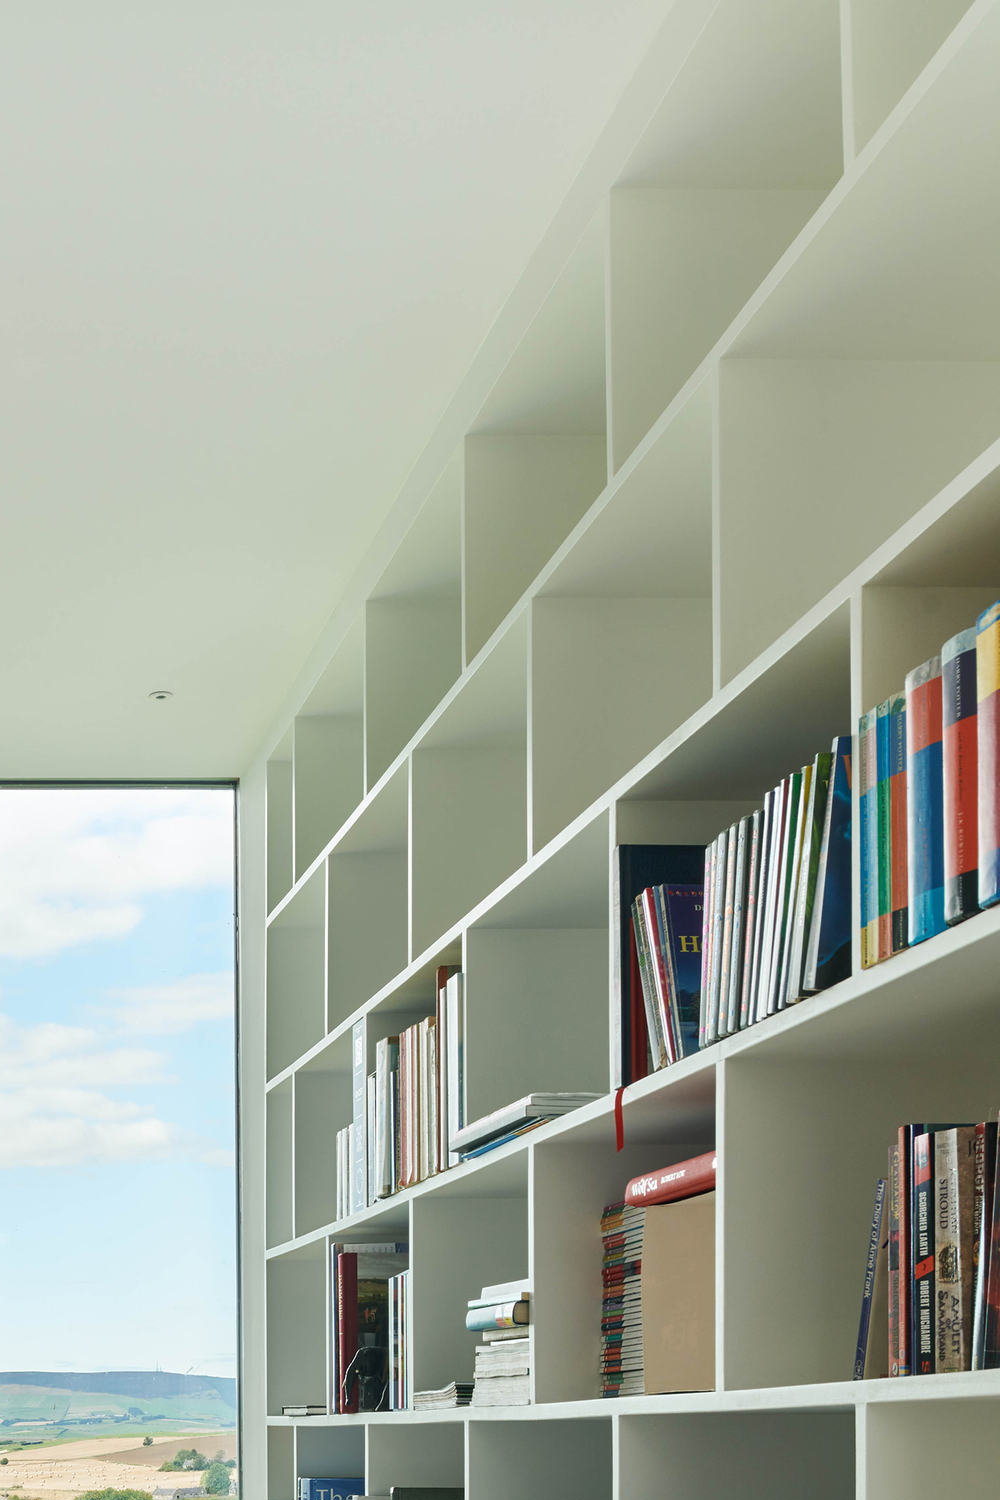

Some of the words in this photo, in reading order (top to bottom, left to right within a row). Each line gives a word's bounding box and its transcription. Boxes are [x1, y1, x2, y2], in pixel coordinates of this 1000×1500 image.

[875, 1182, 885, 1203] The
[939, 1178, 949, 1230] STROUD
[871, 1203, 882, 1230] Diary
[918, 1191, 928, 1231] SCORCHED
[870, 1230, 878, 1241] of
[919, 1232, 929, 1257] EARTH
[867, 1242, 877, 1269] Anne
[863, 1270, 874, 1299] Frank
[919, 1280, 930, 1307] ROBERT
[920, 1309, 931, 1354] MUCHAMORE
[938, 1290, 948, 1362] SAMARKAND
[950, 1295, 960, 1355] AMULET
